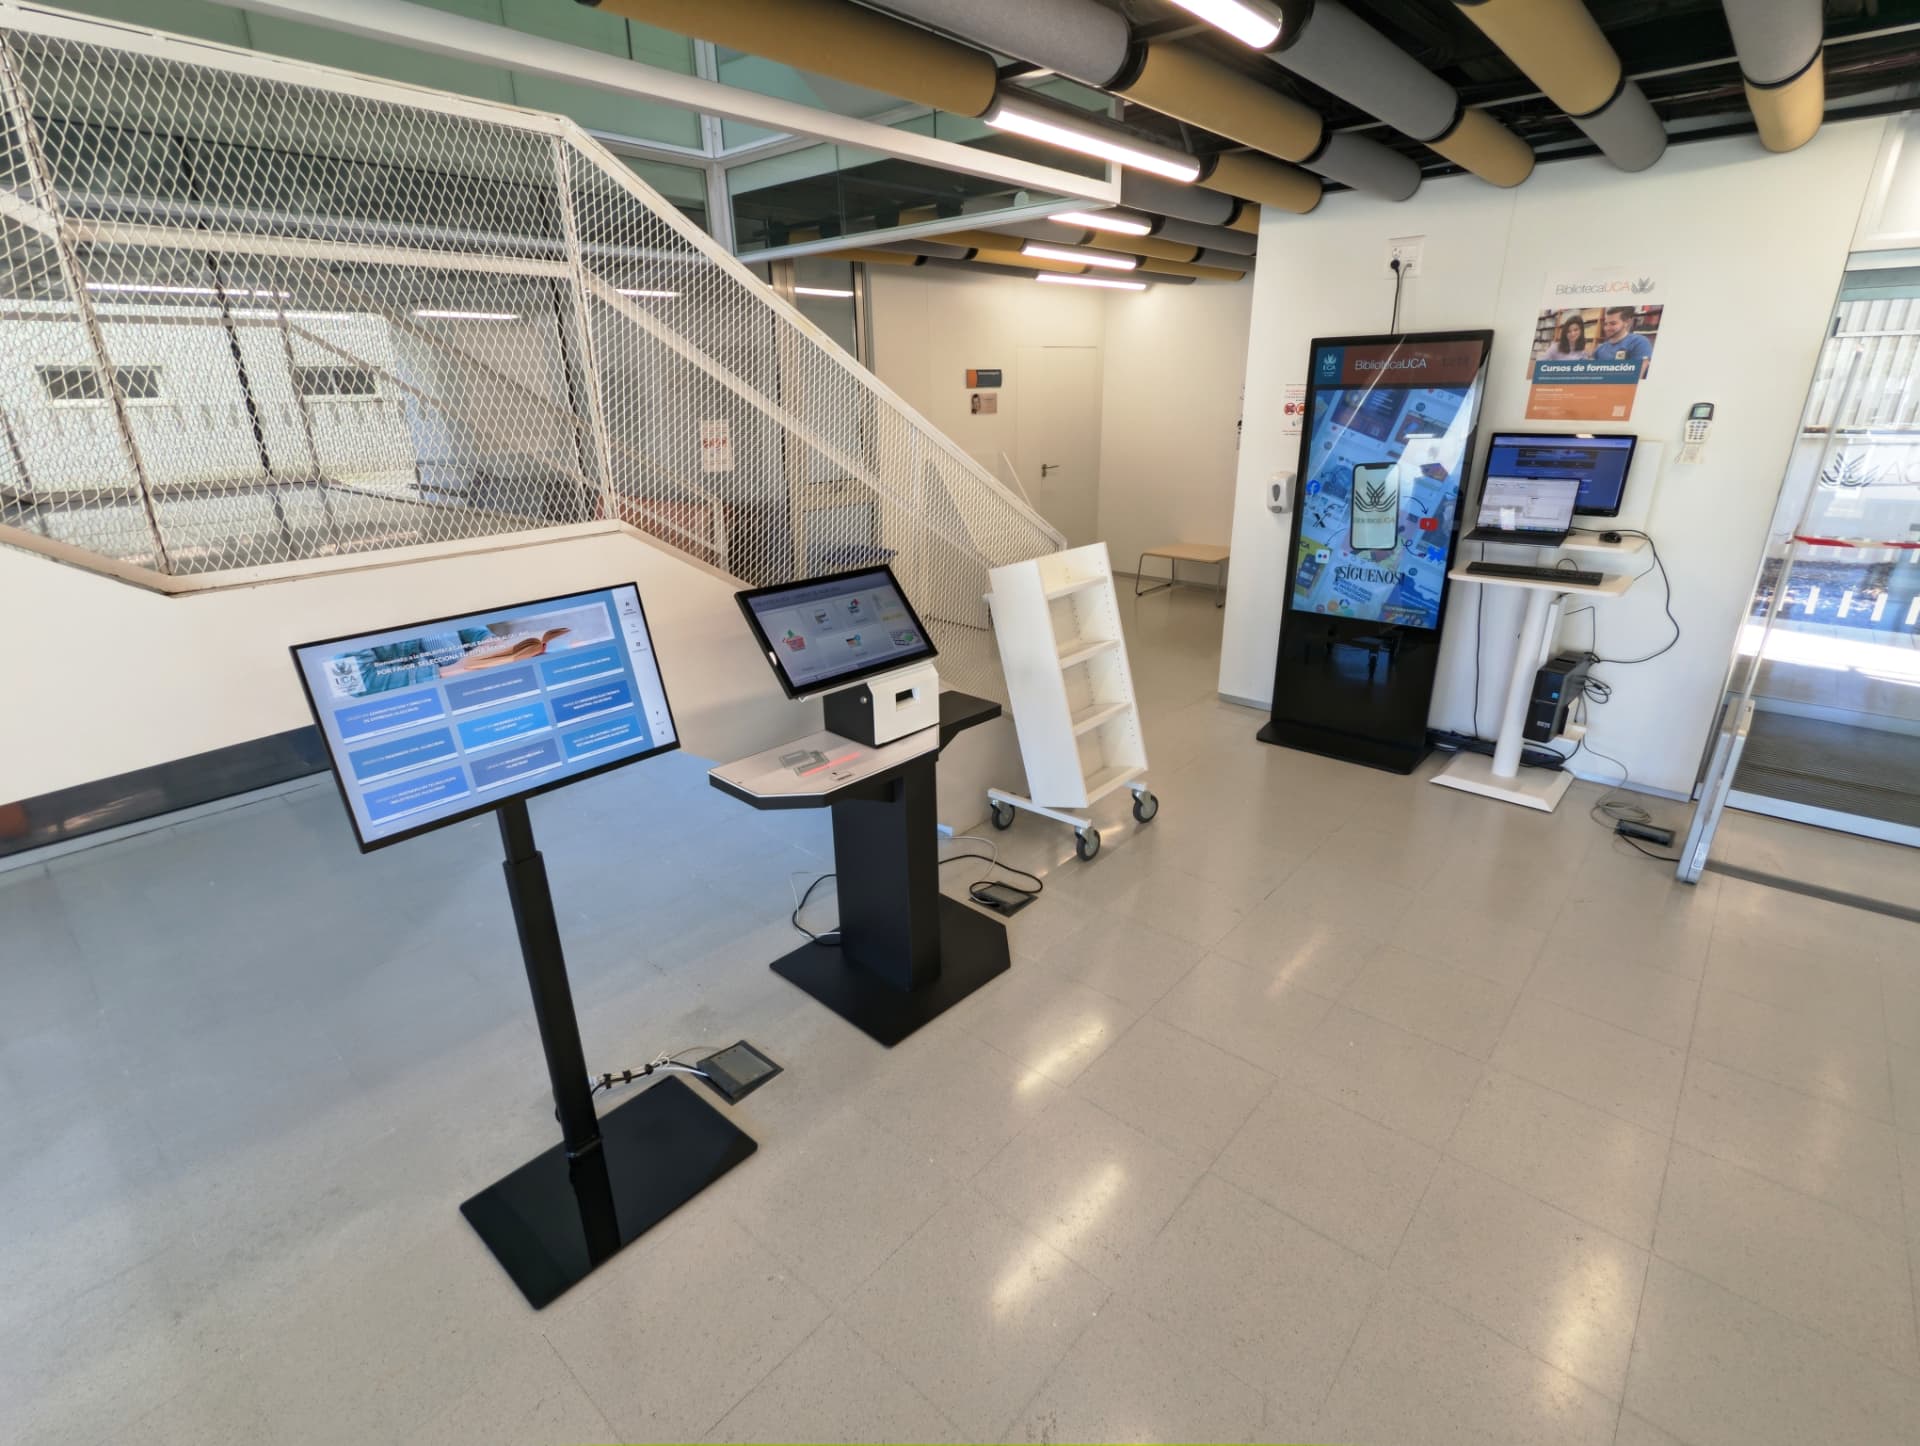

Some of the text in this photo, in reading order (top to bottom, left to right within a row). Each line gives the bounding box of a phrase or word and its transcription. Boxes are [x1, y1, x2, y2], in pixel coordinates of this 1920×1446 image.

[1555, 281, 1631, 296] BibliotecaUCA
[1540, 363, 1636, 373] Cursos de formación
